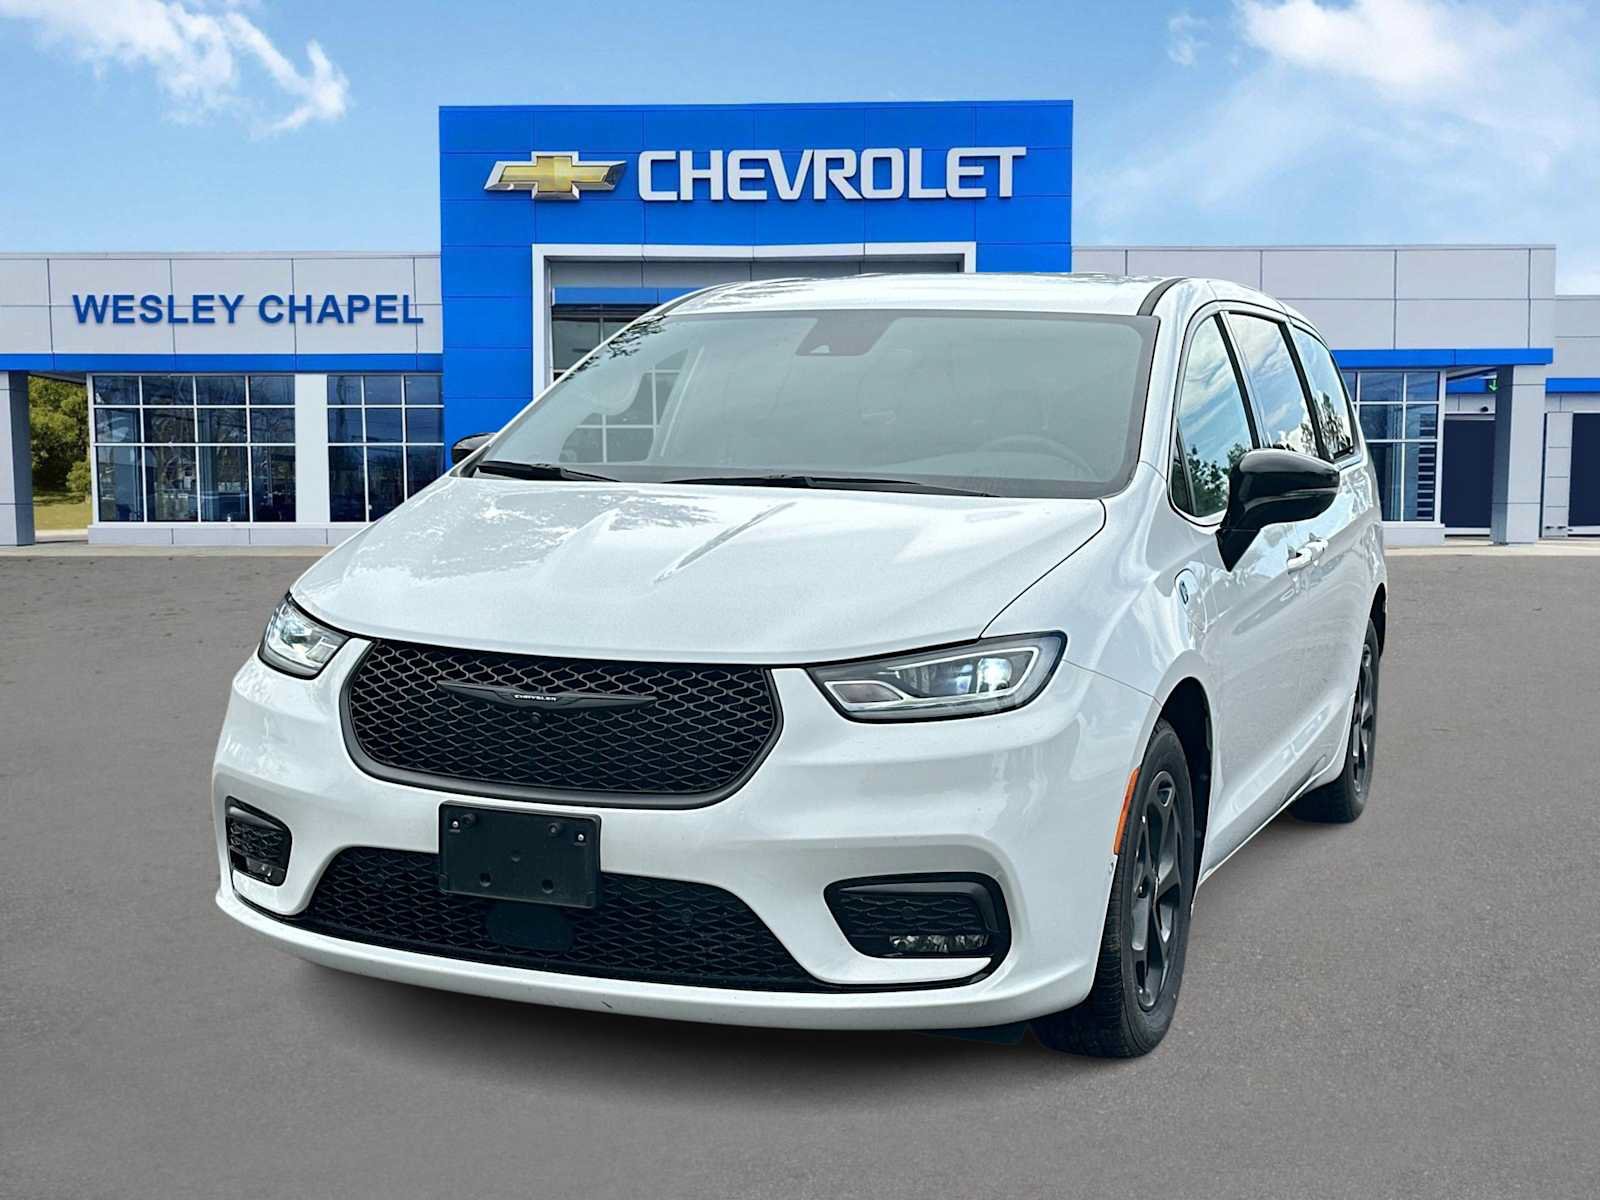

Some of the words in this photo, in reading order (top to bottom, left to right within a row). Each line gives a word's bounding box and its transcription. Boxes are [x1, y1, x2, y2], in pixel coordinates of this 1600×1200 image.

[638, 147, 1027, 201] CHEVROLET
[73, 295, 244, 324] WESLEY
[258, 295, 424, 324] CHAPEL
